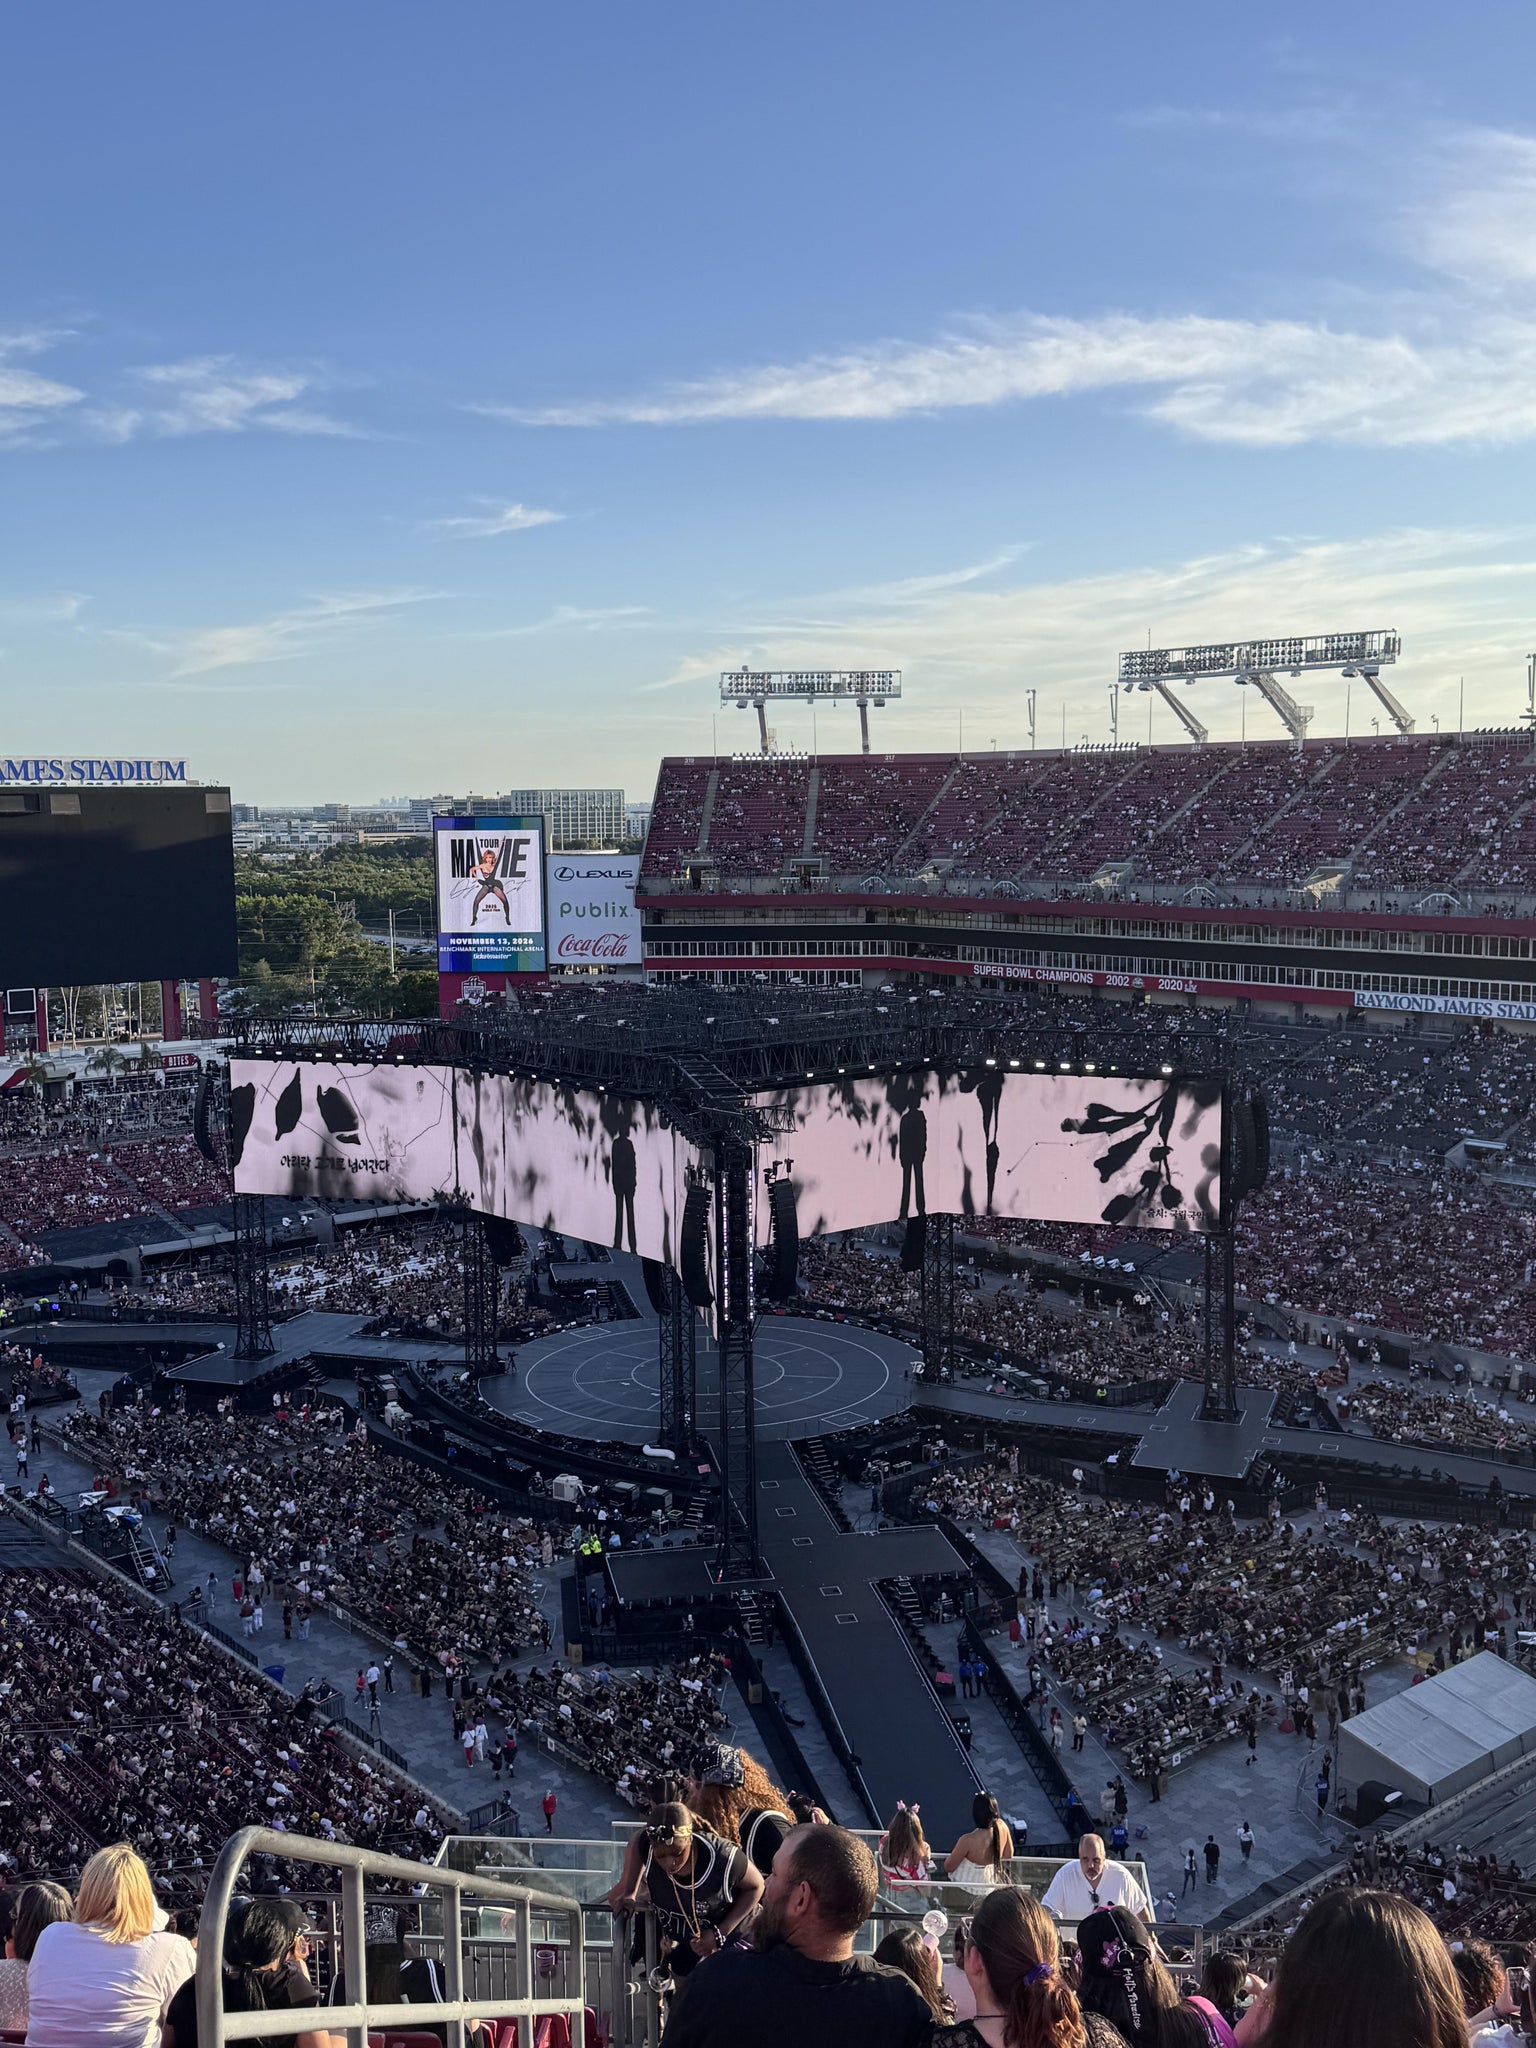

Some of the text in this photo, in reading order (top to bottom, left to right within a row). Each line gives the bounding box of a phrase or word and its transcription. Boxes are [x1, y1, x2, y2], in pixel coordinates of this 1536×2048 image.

[70, 760, 187, 781] STADIUM
[479, 838, 500, 849] TOUR
[576, 870, 633, 879] LEXUS
[560, 901, 628, 918] Publix
[973, 965, 1004, 977] SUPER
[1006, 967, 1034, 980] BOWL
[1035, 969, 1094, 985] CHAMPIONS
[1106, 974, 1130, 987] 2002
[1158, 978, 1183, 991] 2020
[1355, 993, 1436, 1012] RAYMOND
[1438, 999, 1493, 1016] JAMES
[168, 1055, 189, 1067] BITES
[280, 1154, 312, 1172] 아리랑
[347, 1157, 391, 1174] 넘어간다
